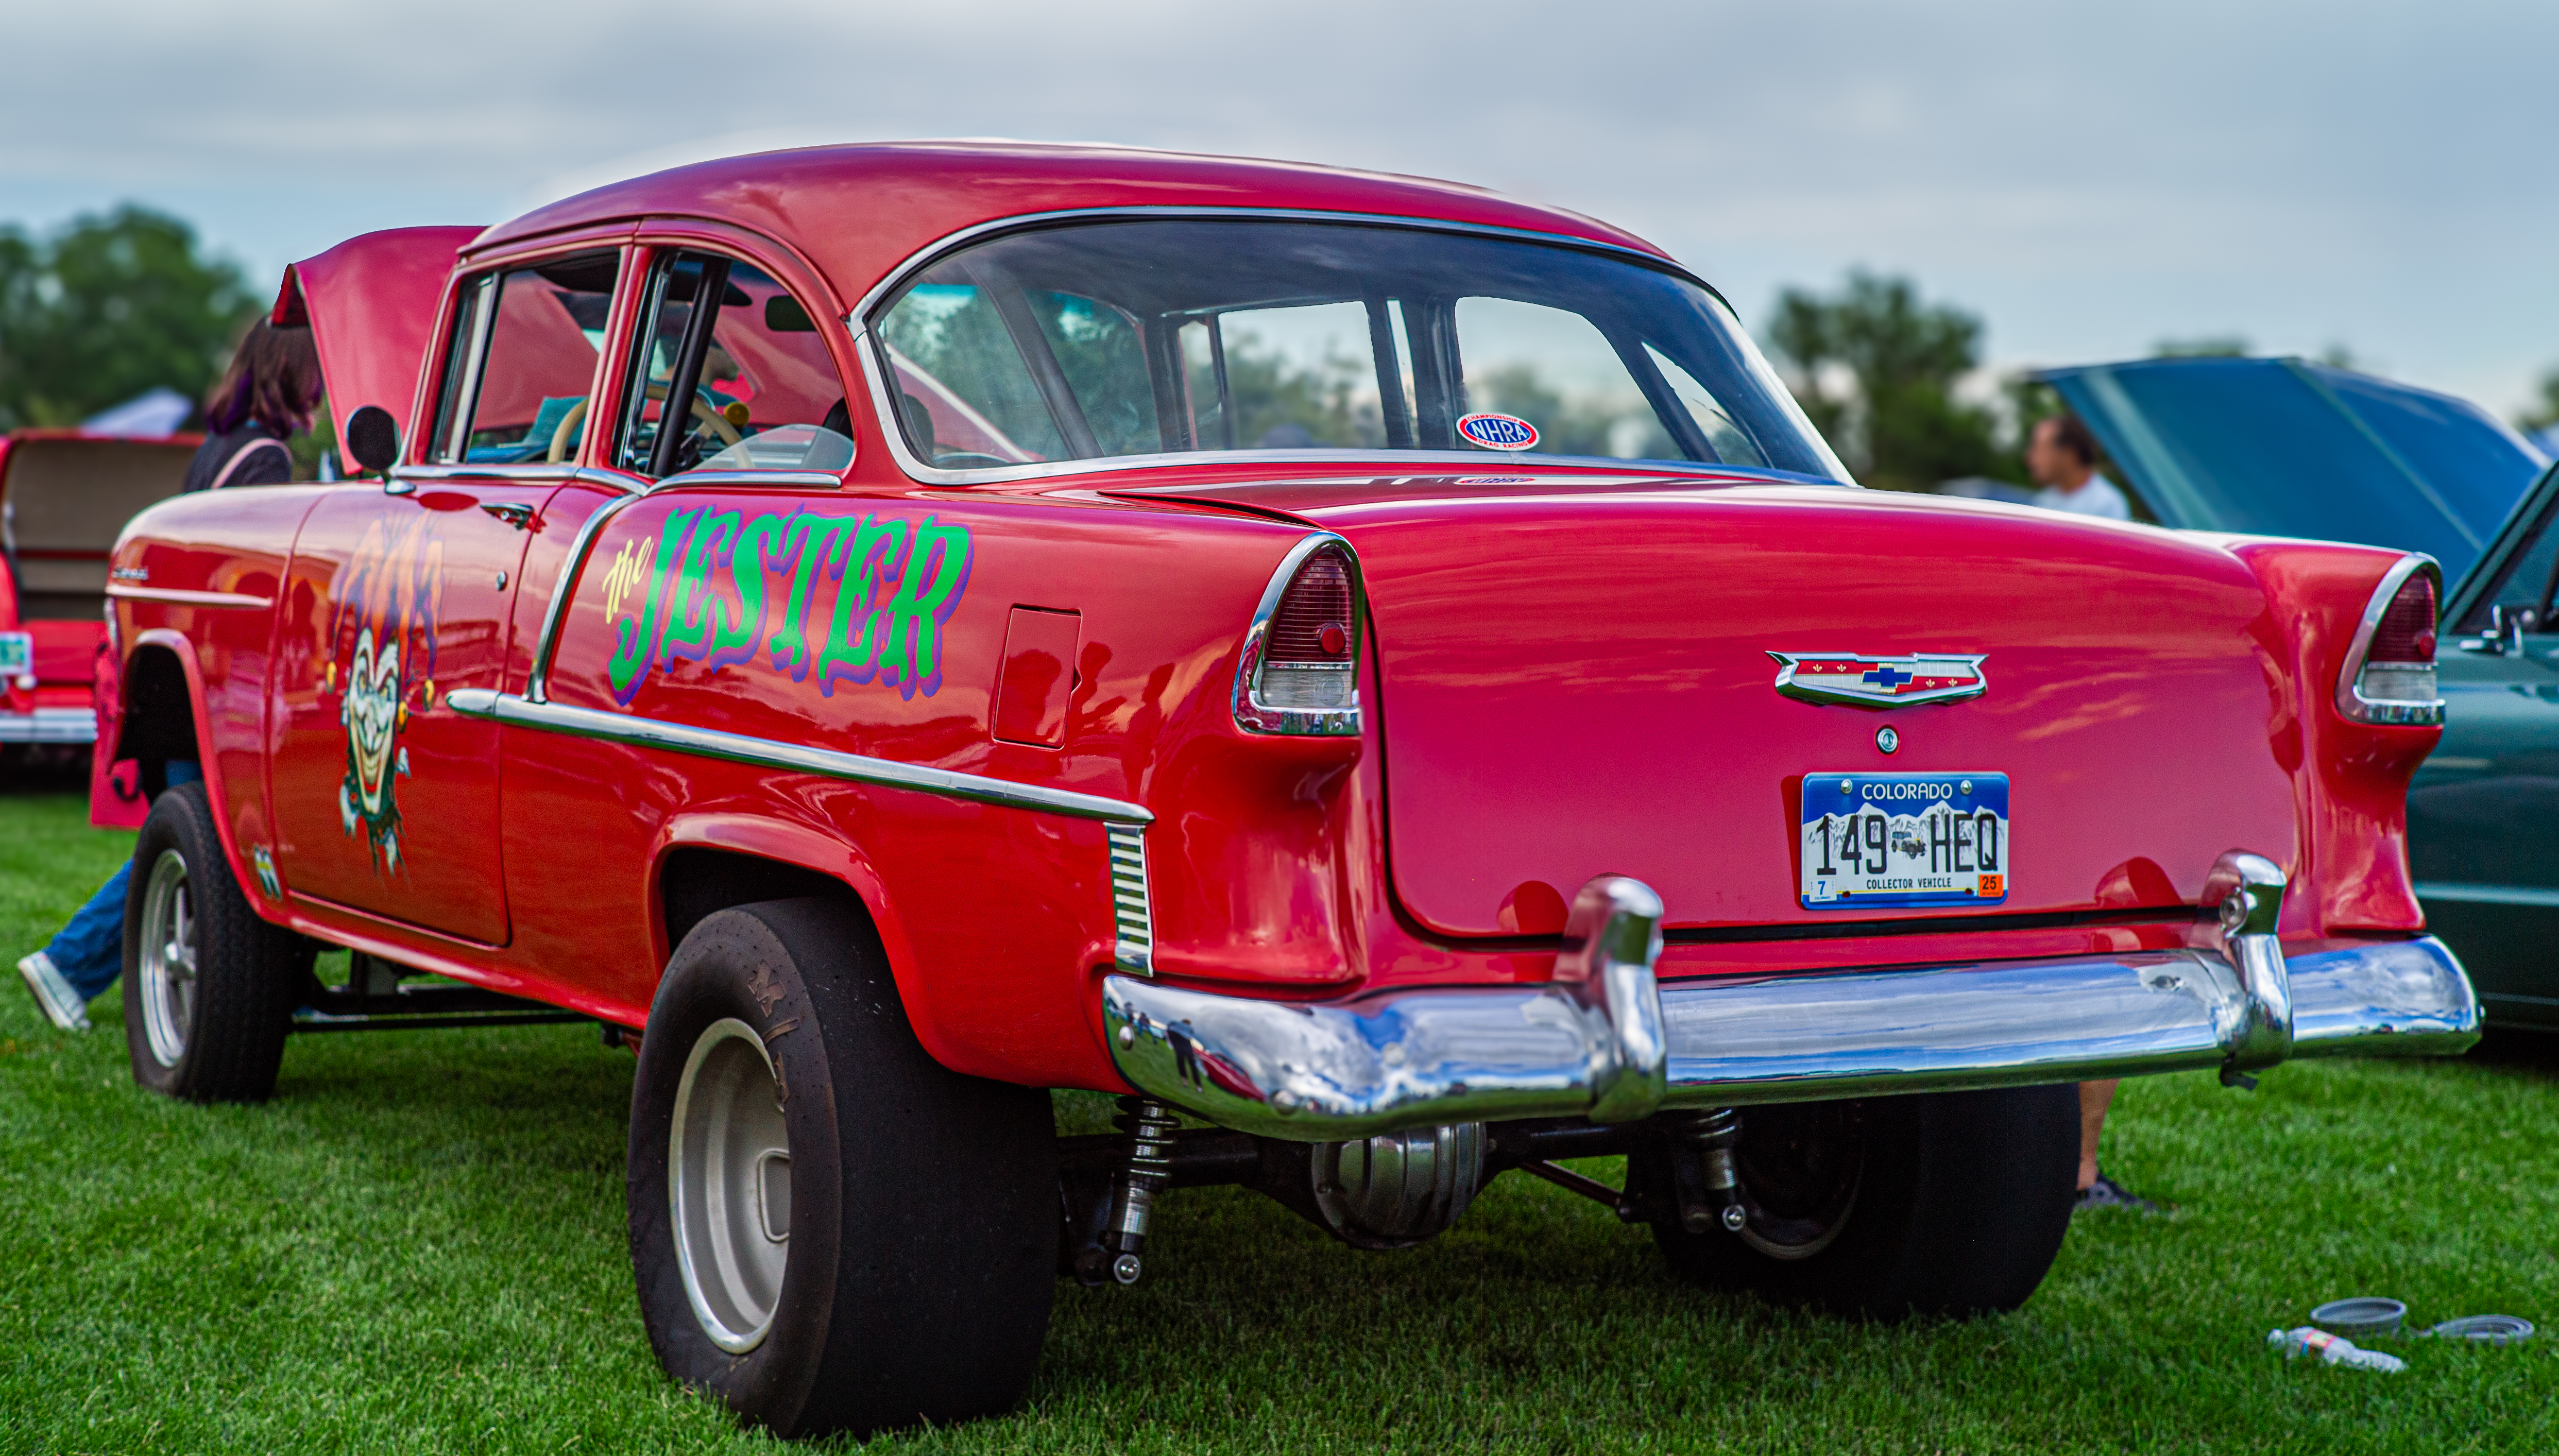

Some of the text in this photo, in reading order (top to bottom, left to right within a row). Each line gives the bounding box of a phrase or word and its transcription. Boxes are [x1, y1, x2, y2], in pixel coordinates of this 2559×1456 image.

[1468, 415, 1518, 423] CHAMPIONSHIP
[1471, 420, 1527, 442] NHRA
[1478, 439, 1499, 448] DRAG
[602, 503, 975, 707] the JESTER
[1862, 783, 1953, 800] COLORADO
[1816, 814, 1998, 875] 149 HEQ
[1818, 881, 1826, 895] 7
[1867, 878, 1951, 889] COLLECTOR VEHICLE
[1982, 876, 1997, 890] 25
